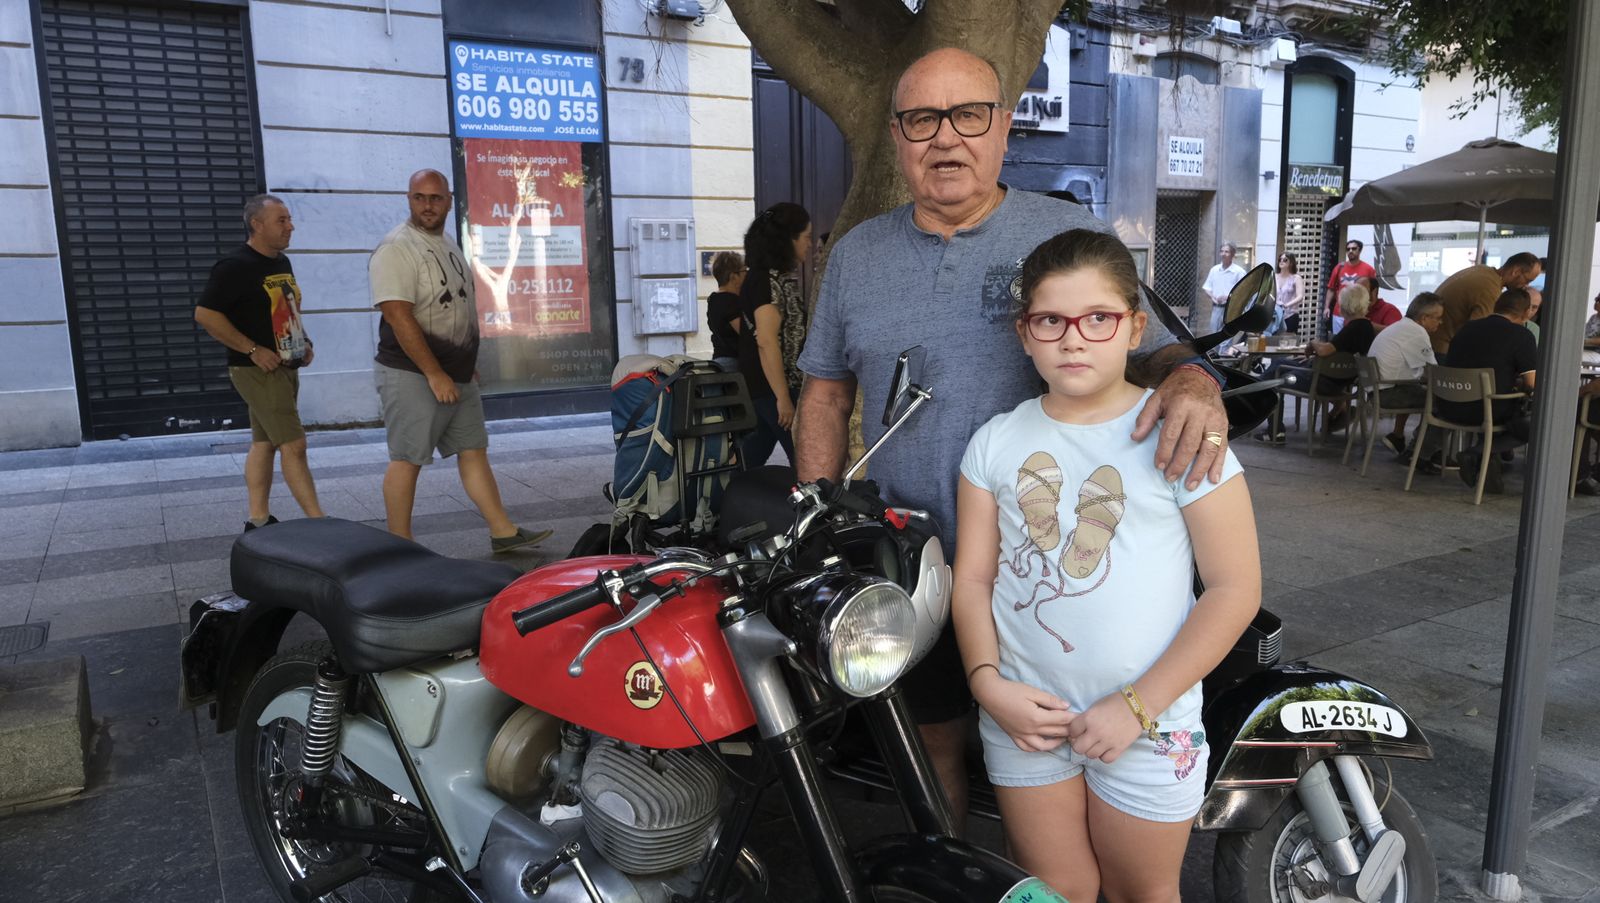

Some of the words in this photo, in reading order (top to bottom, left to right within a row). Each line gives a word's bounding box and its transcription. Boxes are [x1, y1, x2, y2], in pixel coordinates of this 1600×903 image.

[471, 48, 537, 64] HABITA
[542, 53, 594, 68] STATE
[472, 63, 513, 74] Servicios
[516, 65, 571, 77] inmobiliarios
[456, 72, 487, 91] SE
[495, 76, 597, 98] ALQUILA
[457, 94, 501, 118] 606
[509, 97, 551, 121] 980
[559, 100, 599, 123] 555
[460, 122, 545, 133] www.habitastate.com
[553, 125, 574, 135] JOSÉ
[576, 126, 599, 136] LEÓN
[1170, 140, 1178, 153] SE
[1179, 141, 1202, 155] ALQUILA
[476, 153, 487, 162] Se
[529, 155, 557, 165] negocio
[1170, 159, 1179, 172] 667
[1181, 159, 1187, 173] 70
[1189, 160, 1195, 173] 27
[1196, 160, 1202, 174] 21
[1290, 167, 1342, 188] Benedetum
[540, 350, 569, 359] SHOP
[571, 348, 610, 358] ONLINE
[552, 363, 580, 372] OPEN
[1383, 711, 1393, 732] J
